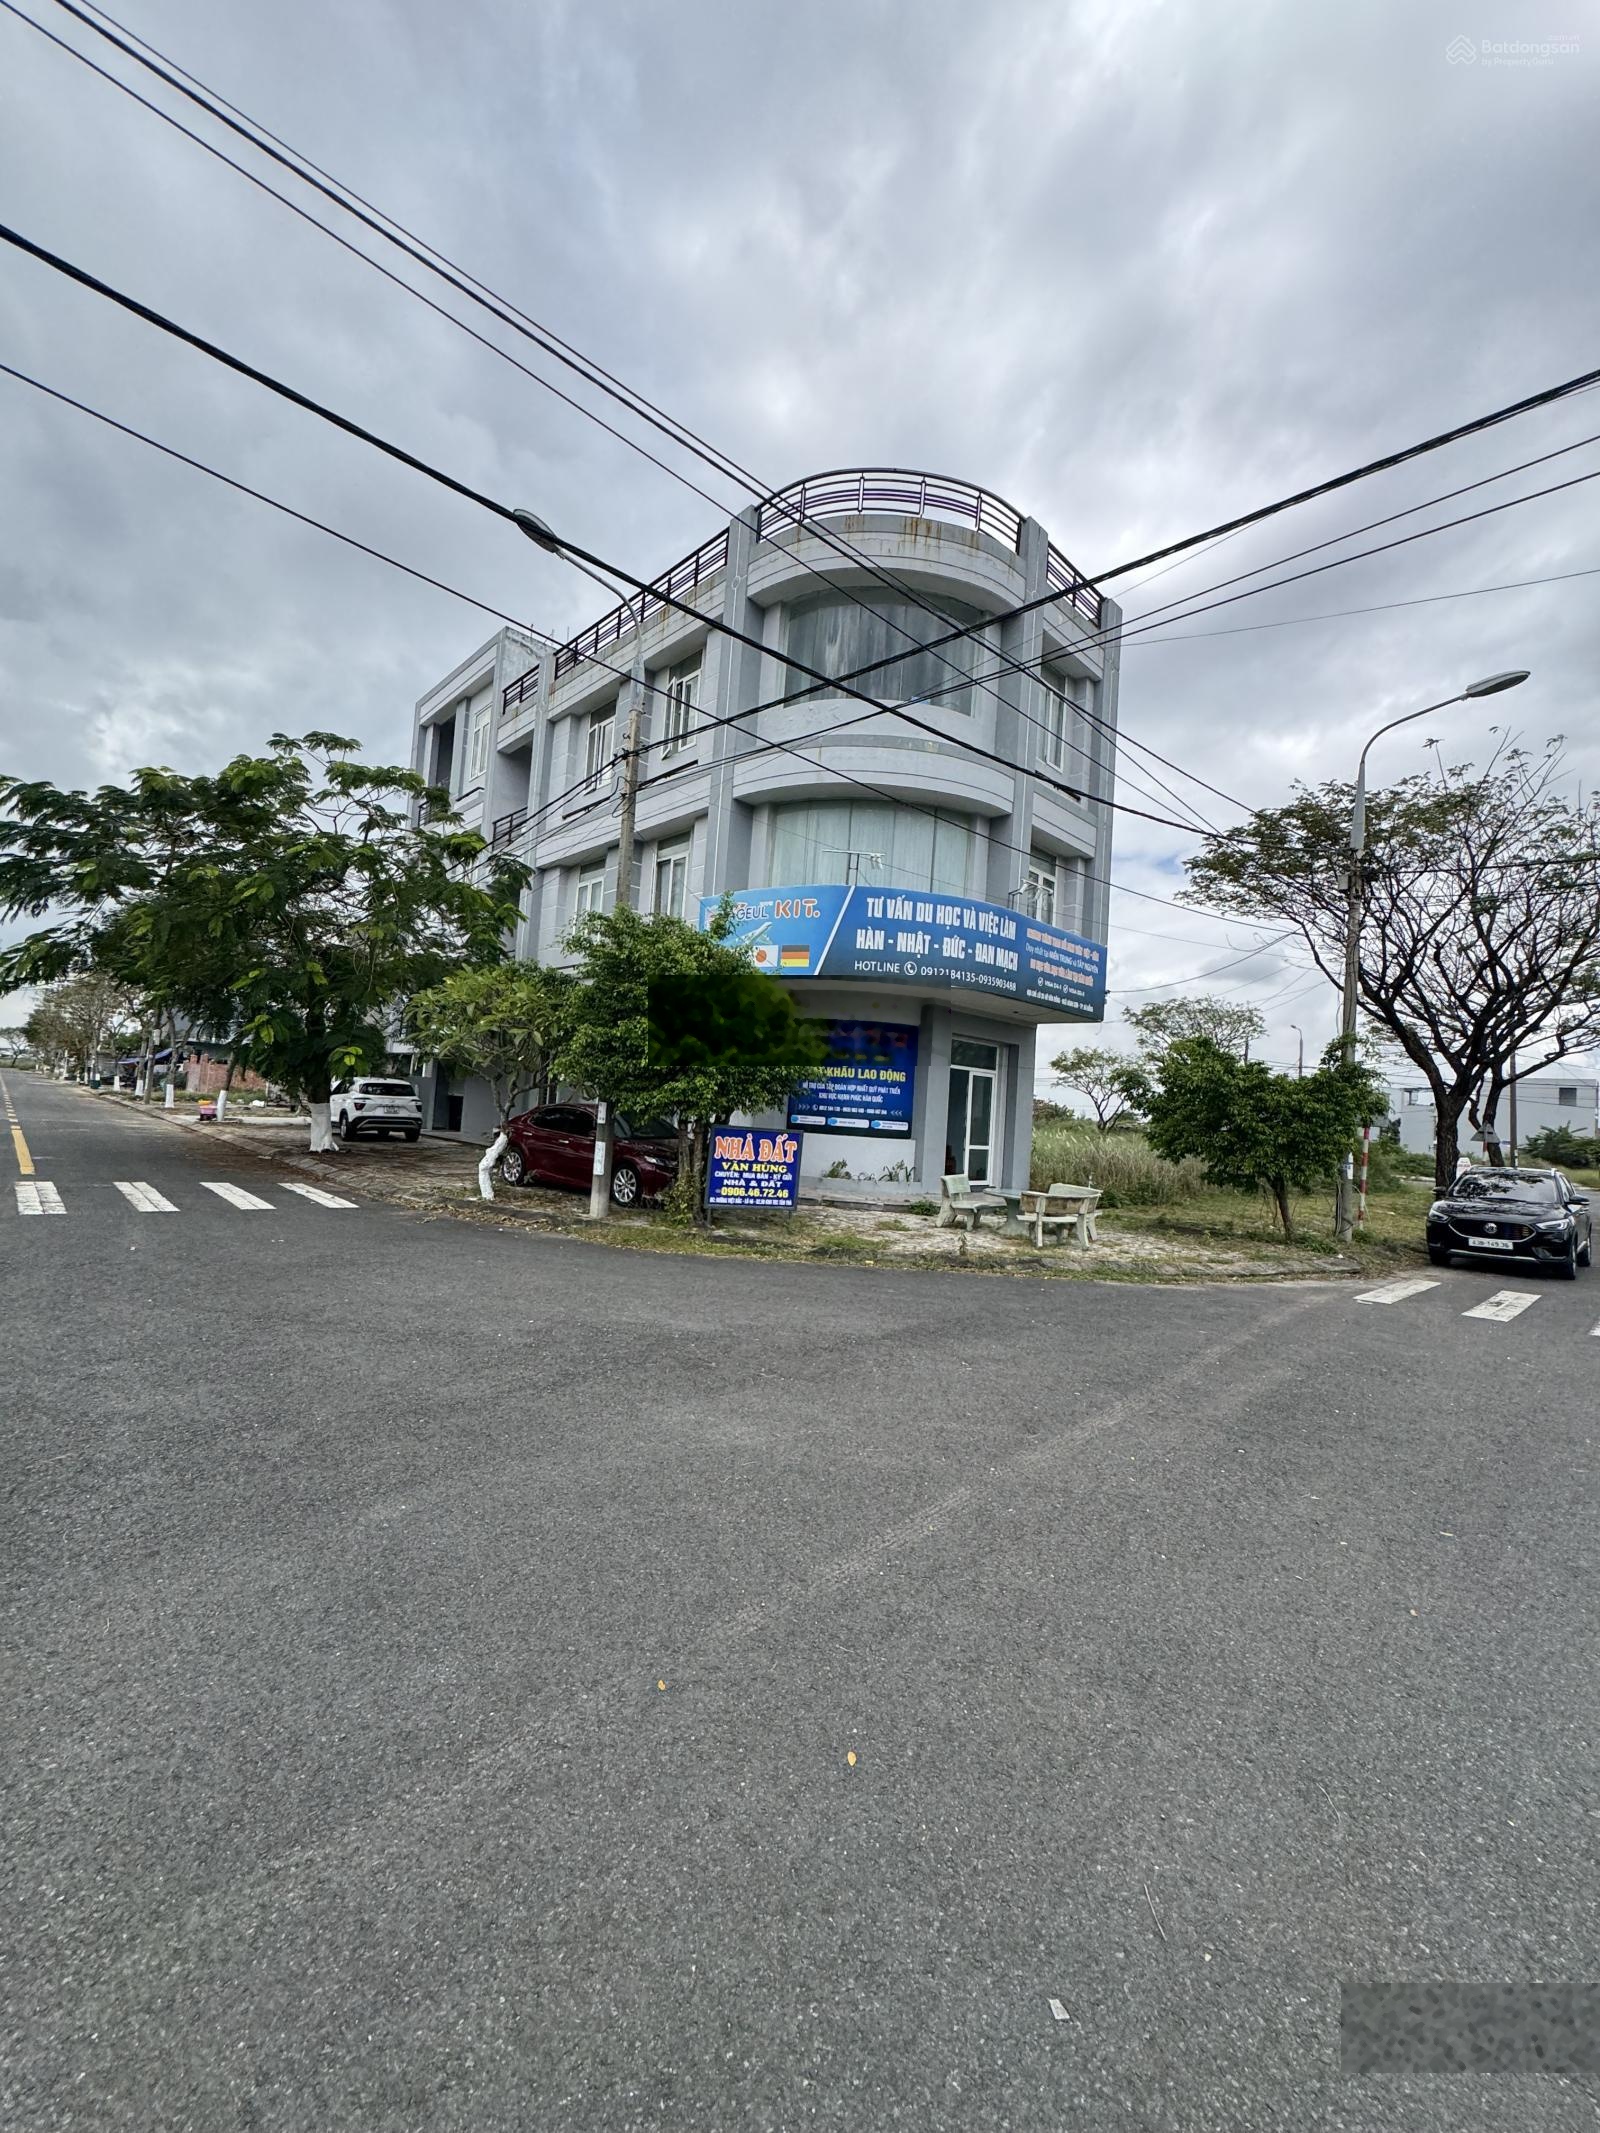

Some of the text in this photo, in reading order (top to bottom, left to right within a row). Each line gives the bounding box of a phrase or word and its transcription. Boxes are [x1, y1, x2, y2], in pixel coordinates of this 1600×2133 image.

[867, 896, 884, 918] TƯ
[887, 894, 913, 921] VẤN
[916, 902, 933, 923] DU
[936, 904, 961, 930] HỌC
[964, 906, 976, 930] VÀ
[979, 911, 999, 938] VIỆC
[1000, 916, 1017, 941] LÀM
[856, 926, 884, 950] HÀN
[897, 931, 931, 958] NHẬT
[942, 934, 966, 959] ĐỨC
[975, 942, 995, 965] ĐAN
[996, 948, 1018, 973] MẠCH
[855, 960, 900, 973] HOTLINE
[858, 1068, 877, 1080] LAO
[880, 1068, 906, 1083] ĐỘNG
[714, 1133, 797, 1163] NHÀ ĐẤT
[722, 1161, 787, 1173] VĂN HÙNG
[723, 1178, 746, 1186] NHÀ
[761, 1179, 783, 1188] ĐẤT
